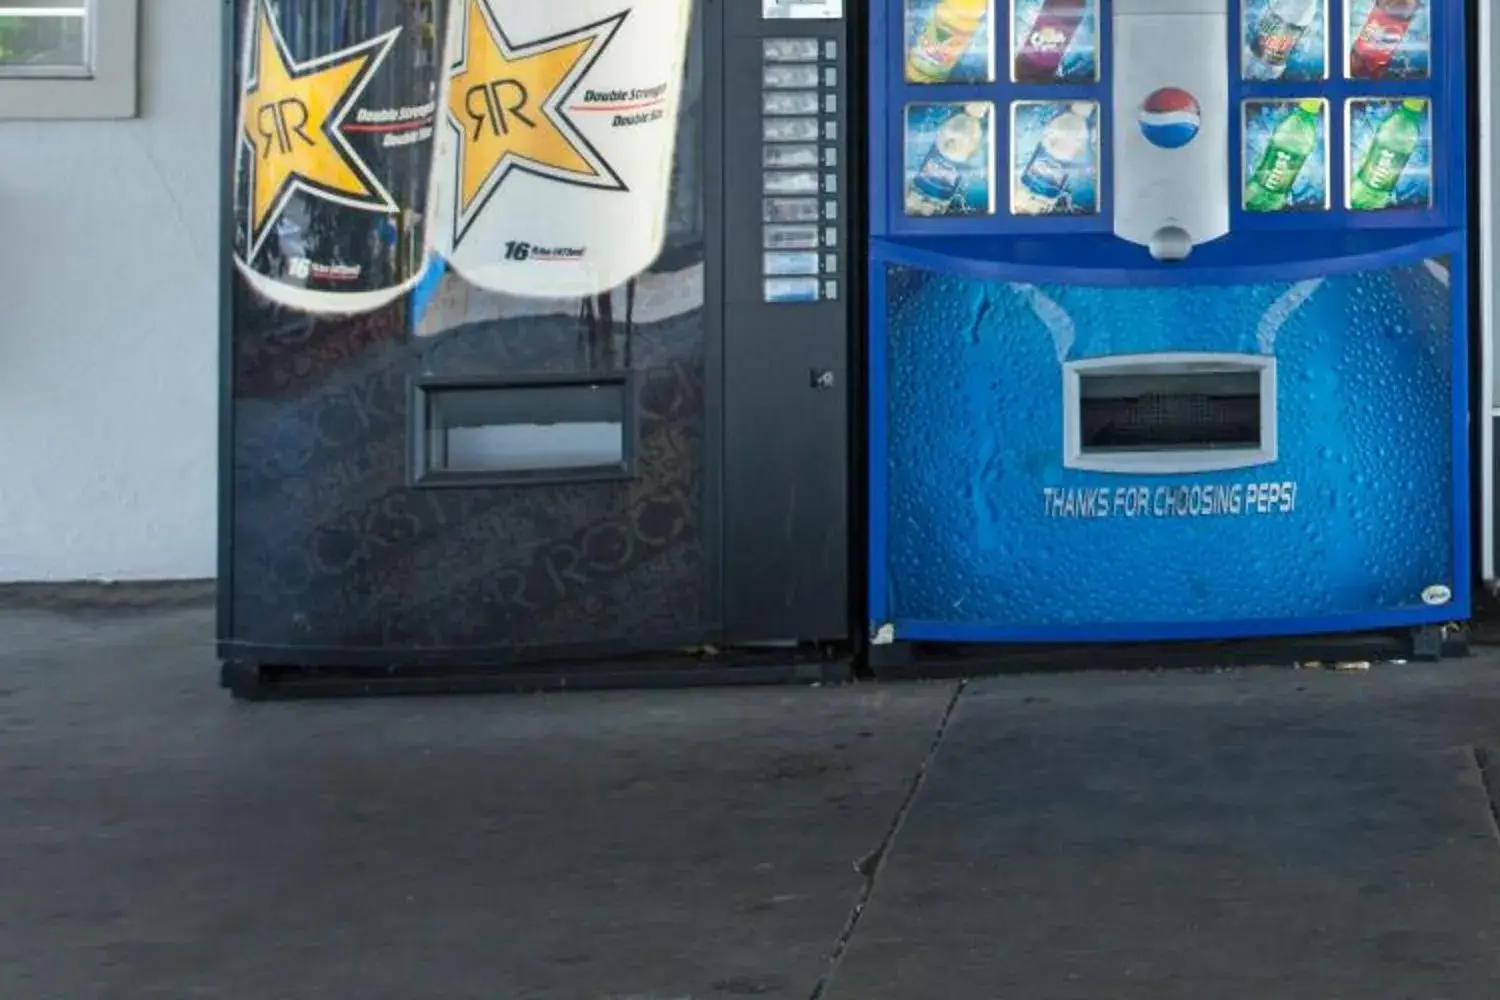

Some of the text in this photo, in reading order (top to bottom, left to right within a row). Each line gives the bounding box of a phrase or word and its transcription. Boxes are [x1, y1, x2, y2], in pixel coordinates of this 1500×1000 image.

[504, 240, 531, 261] 16
[1043, 481, 1298, 517] THANKS FOR CHOOSING PEPSI
